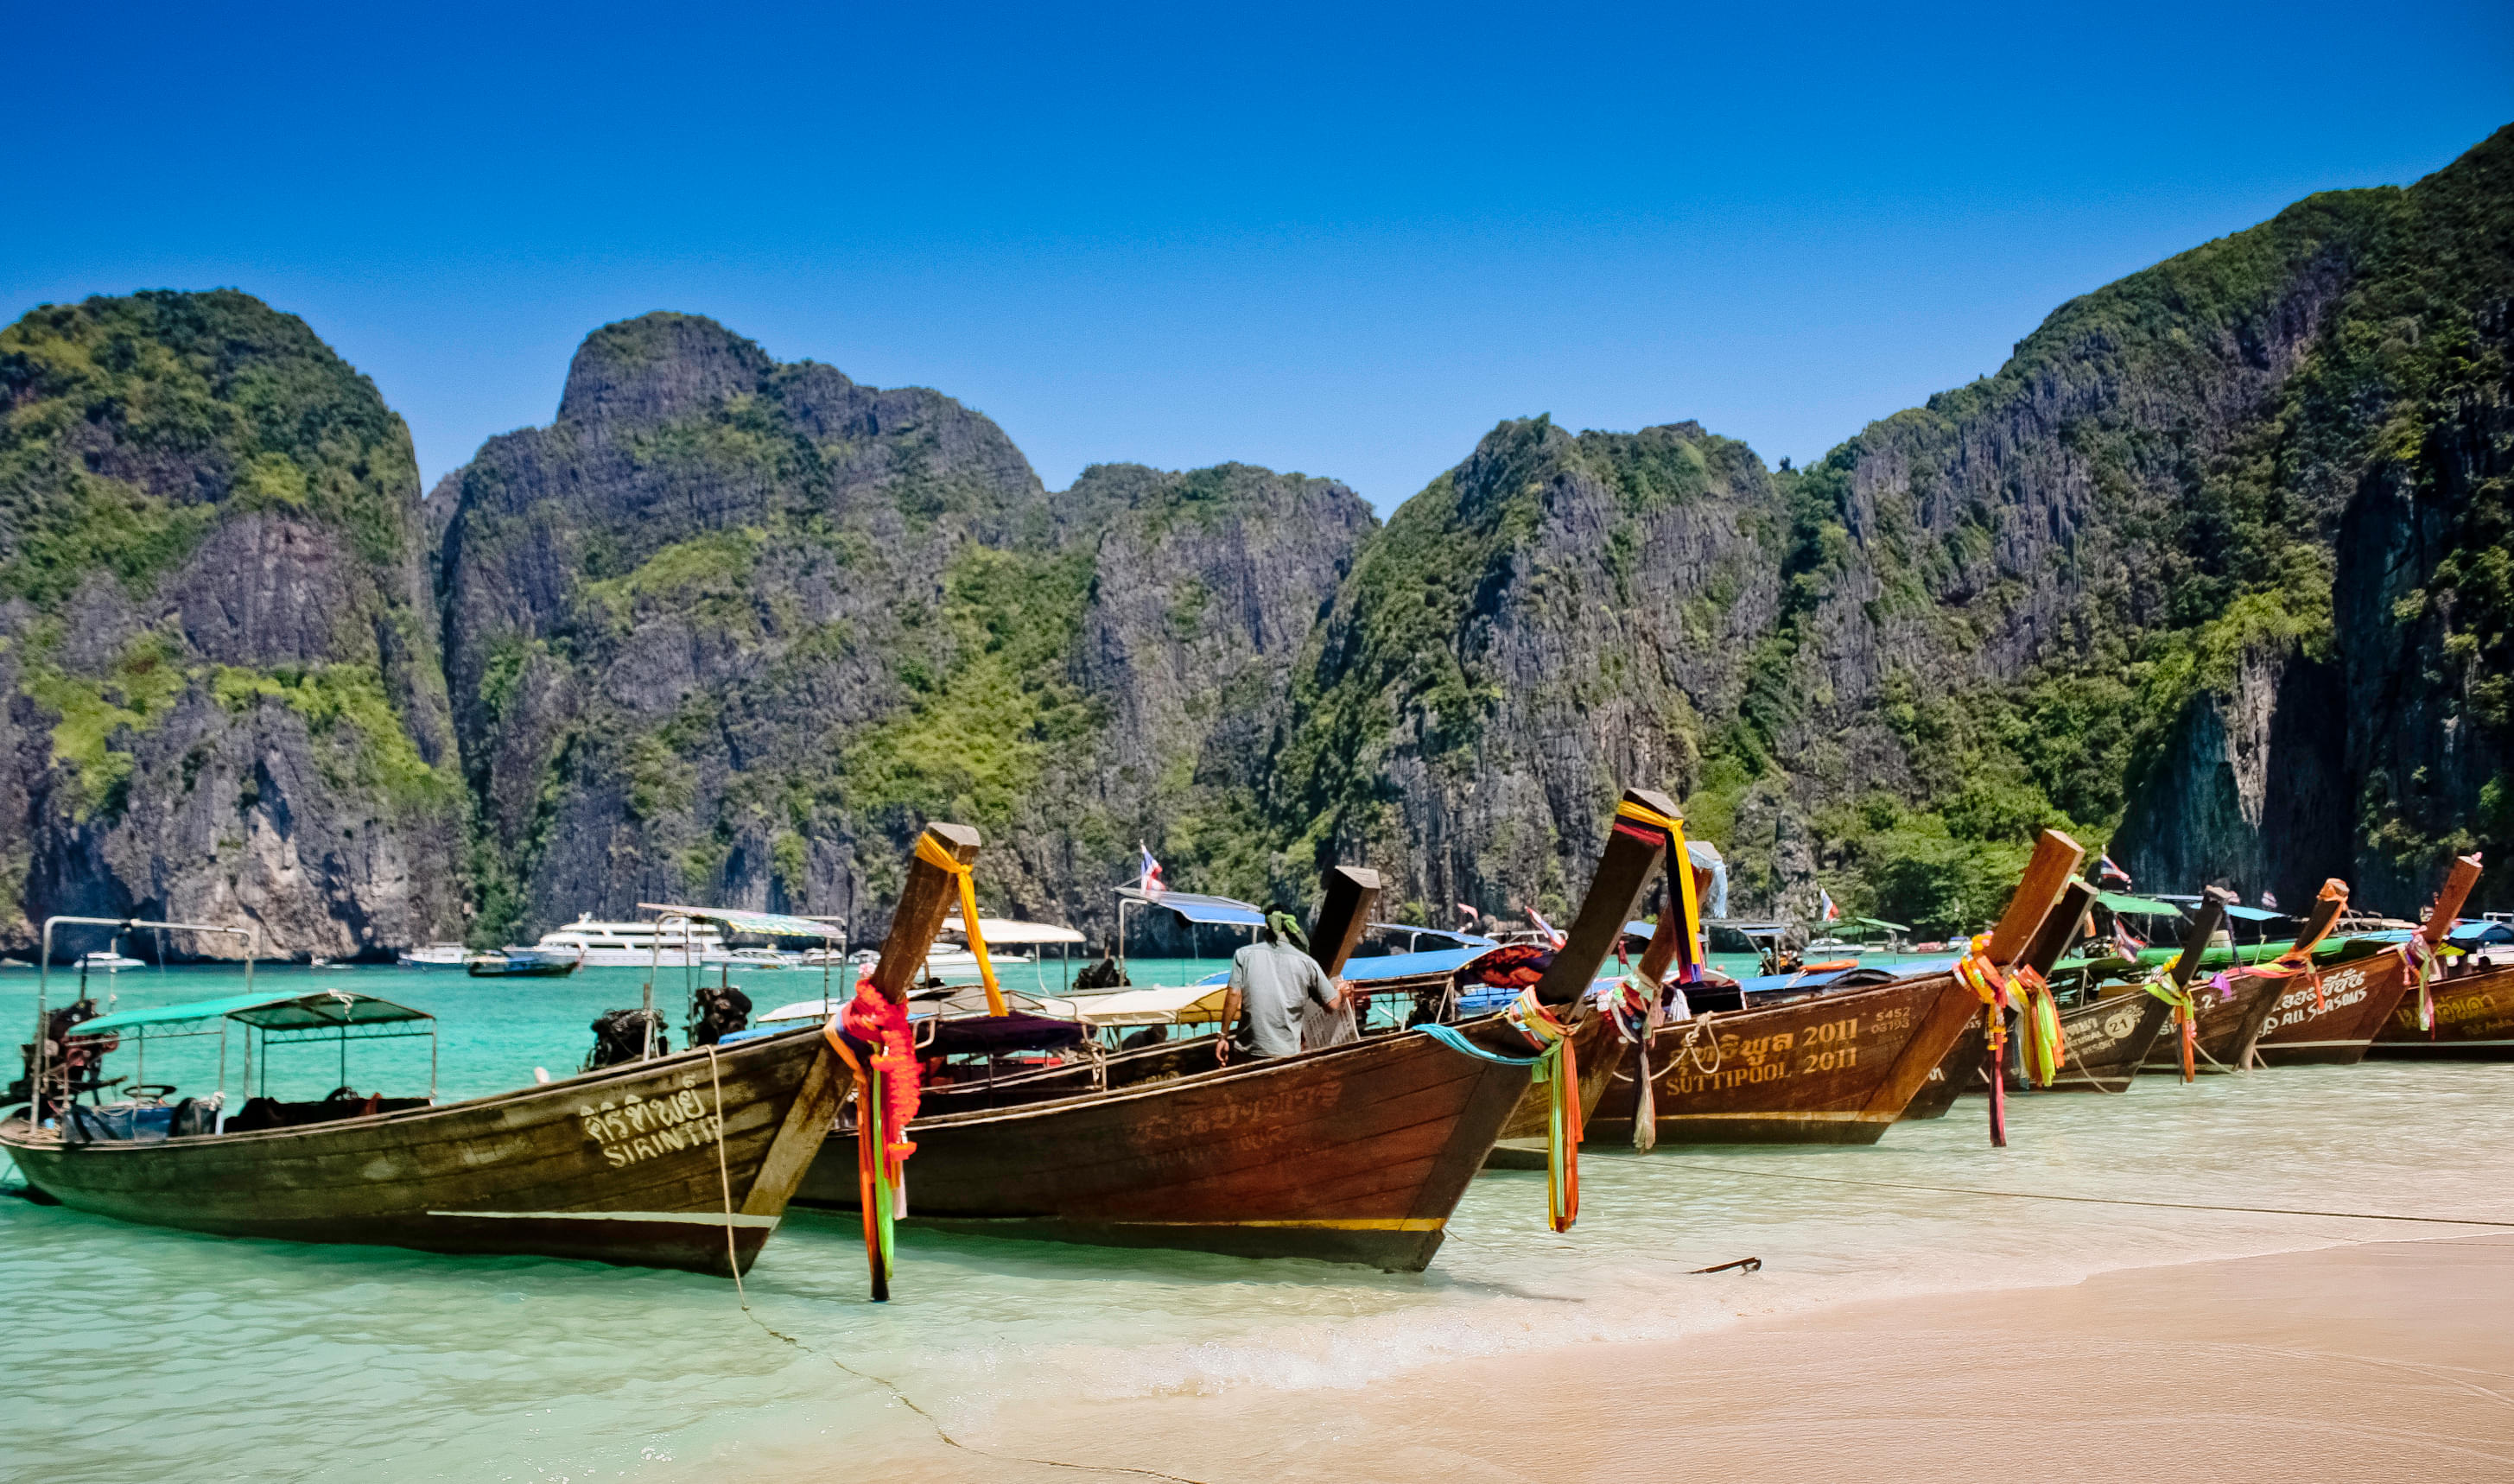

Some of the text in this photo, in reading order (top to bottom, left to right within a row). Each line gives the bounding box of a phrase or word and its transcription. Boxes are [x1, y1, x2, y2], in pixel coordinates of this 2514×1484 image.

[1803, 1018, 1858, 1047] 2011
[2110, 1018, 2128, 1033] 21
[1666, 1046, 1857, 1096] SUTTIPOOL 2011
